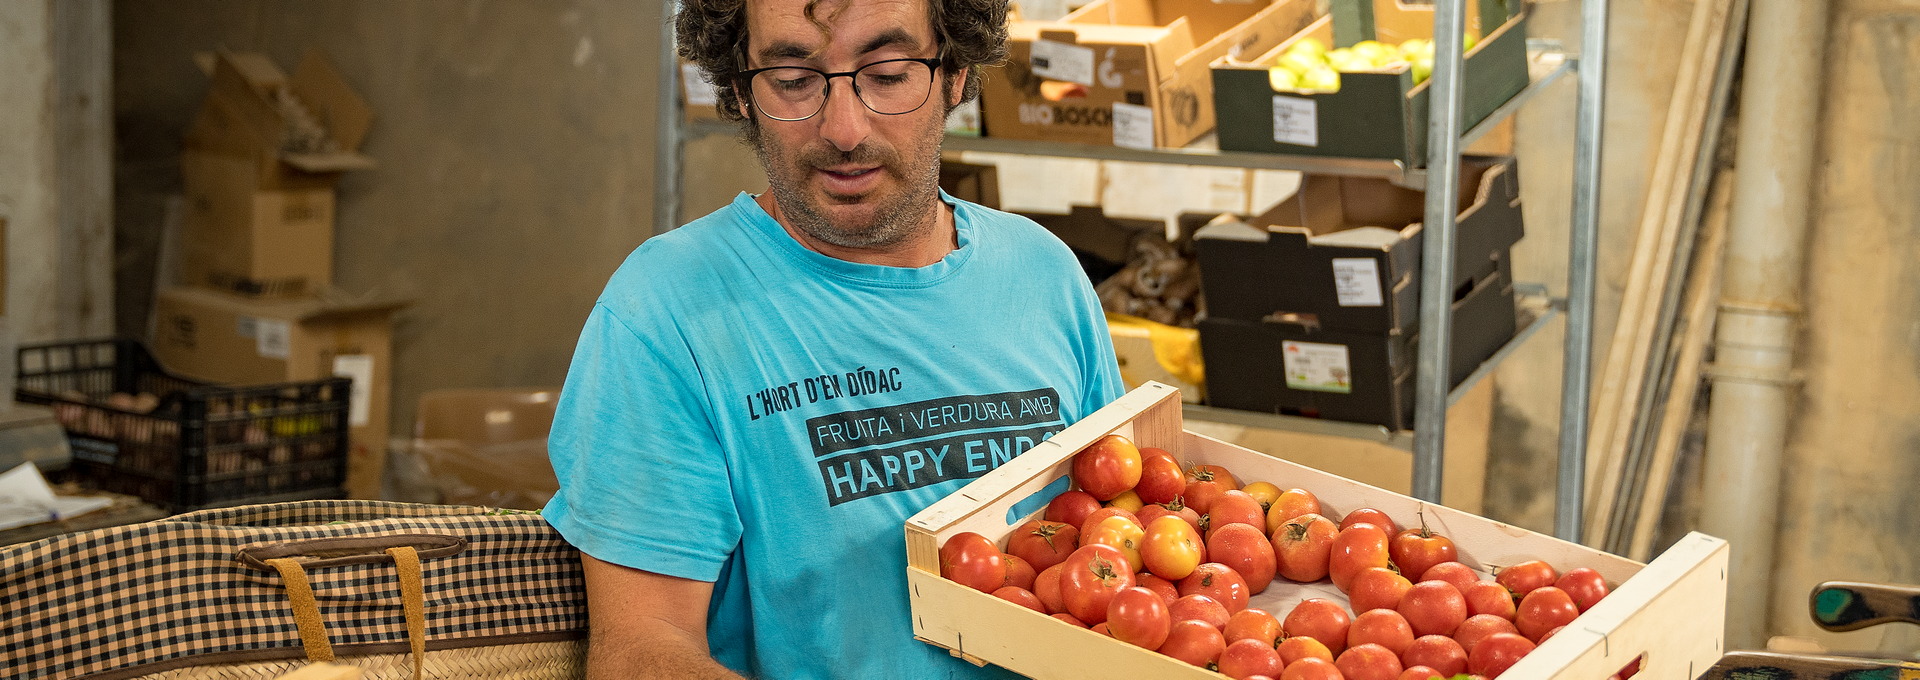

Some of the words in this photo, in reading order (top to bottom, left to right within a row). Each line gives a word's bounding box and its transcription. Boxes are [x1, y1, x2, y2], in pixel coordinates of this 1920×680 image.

[747, 381, 801, 421] L'HORT
[803, 374, 844, 404] D'EN
[846, 366, 903, 398] DÍDAC
[817, 417, 894, 447] FRUITA
[899, 413, 906, 432] i
[909, 400, 1014, 430] VERDURA
[1019, 396, 1054, 419] AMB
[827, 444, 951, 499] HAPPY
